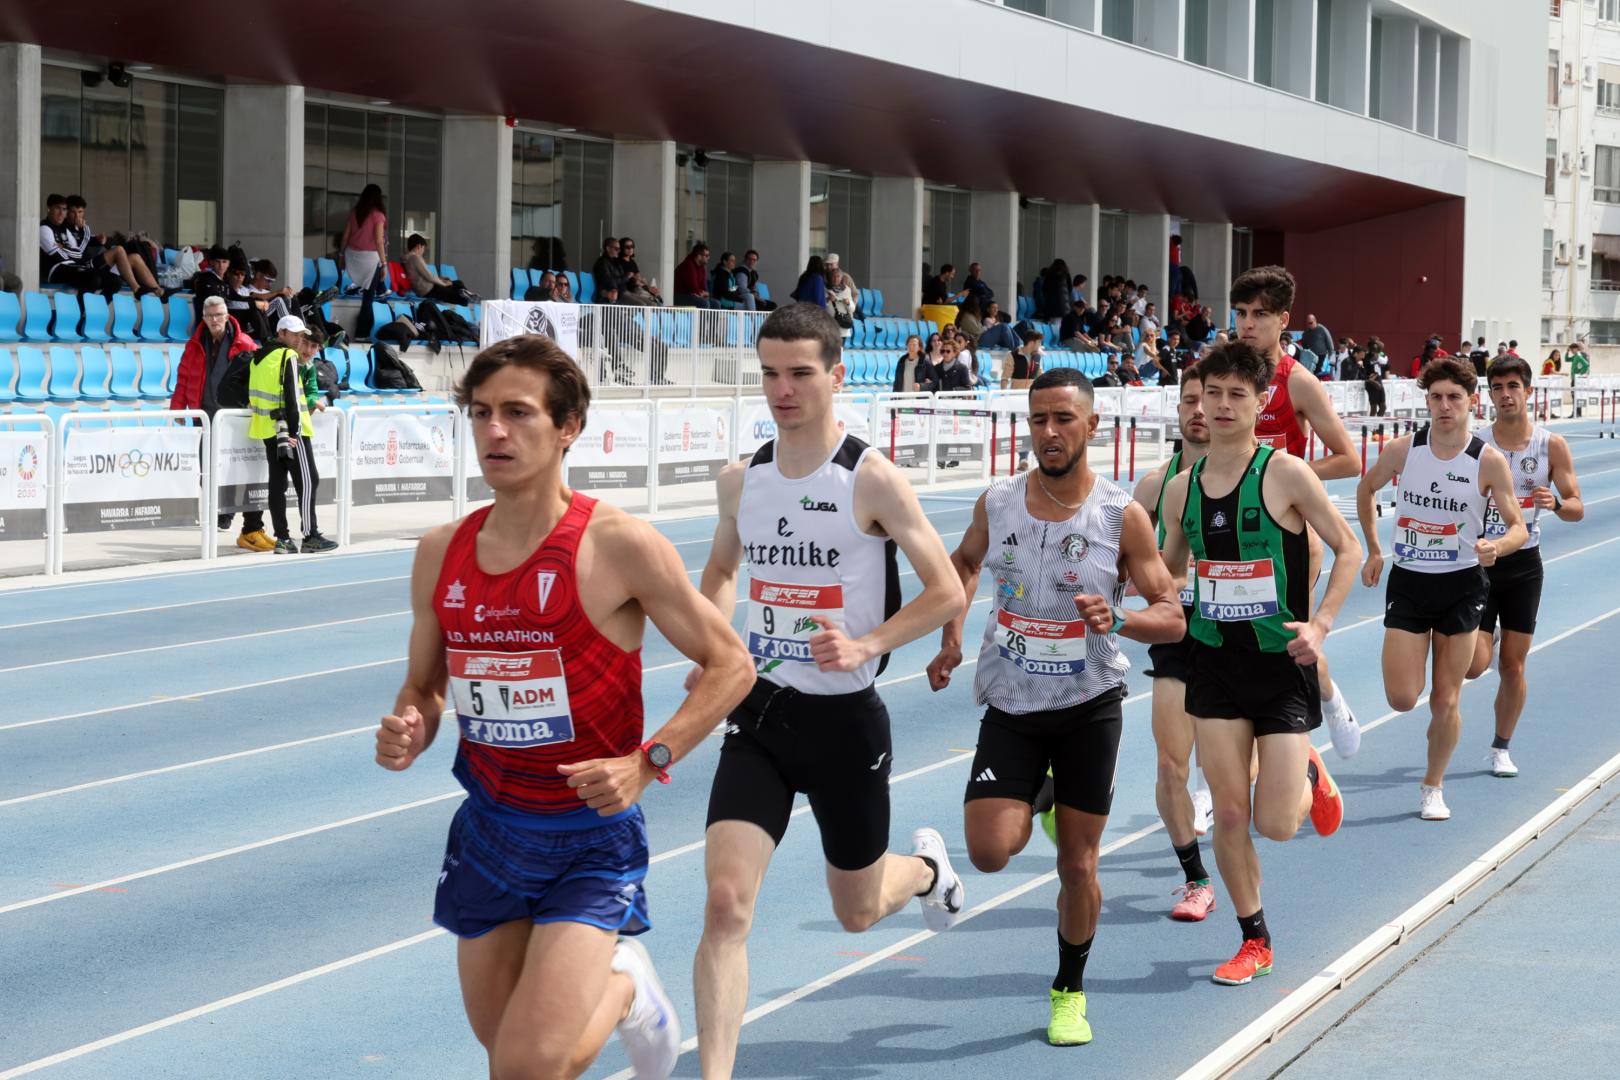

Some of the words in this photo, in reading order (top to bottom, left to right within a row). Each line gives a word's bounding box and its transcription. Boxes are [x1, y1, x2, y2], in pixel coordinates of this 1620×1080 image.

[89, 454, 116, 474] JDN
[154, 452, 180, 471] NKJ
[17, 489, 36, 498] 2030
[100, 507, 130, 518] NAVARRA
[1486, 508, 1499, 523] 25
[1404, 528, 1417, 546] 10
[1492, 525, 1506, 534] Jo
[1412, 548, 1450, 559] Joma
[1208, 579, 1217, 601] 7
[1217, 603, 1266, 619] Joma
[763, 606, 775, 635] 9
[469, 630, 554, 643] MARATHON
[1006, 630, 1027, 656] 26
[770, 639, 812, 658] Jom
[1022, 657, 1073, 674] Joma
[470, 681, 484, 716] 5
[512, 687, 555, 705] ADM
[484, 721, 554, 742] Joma
